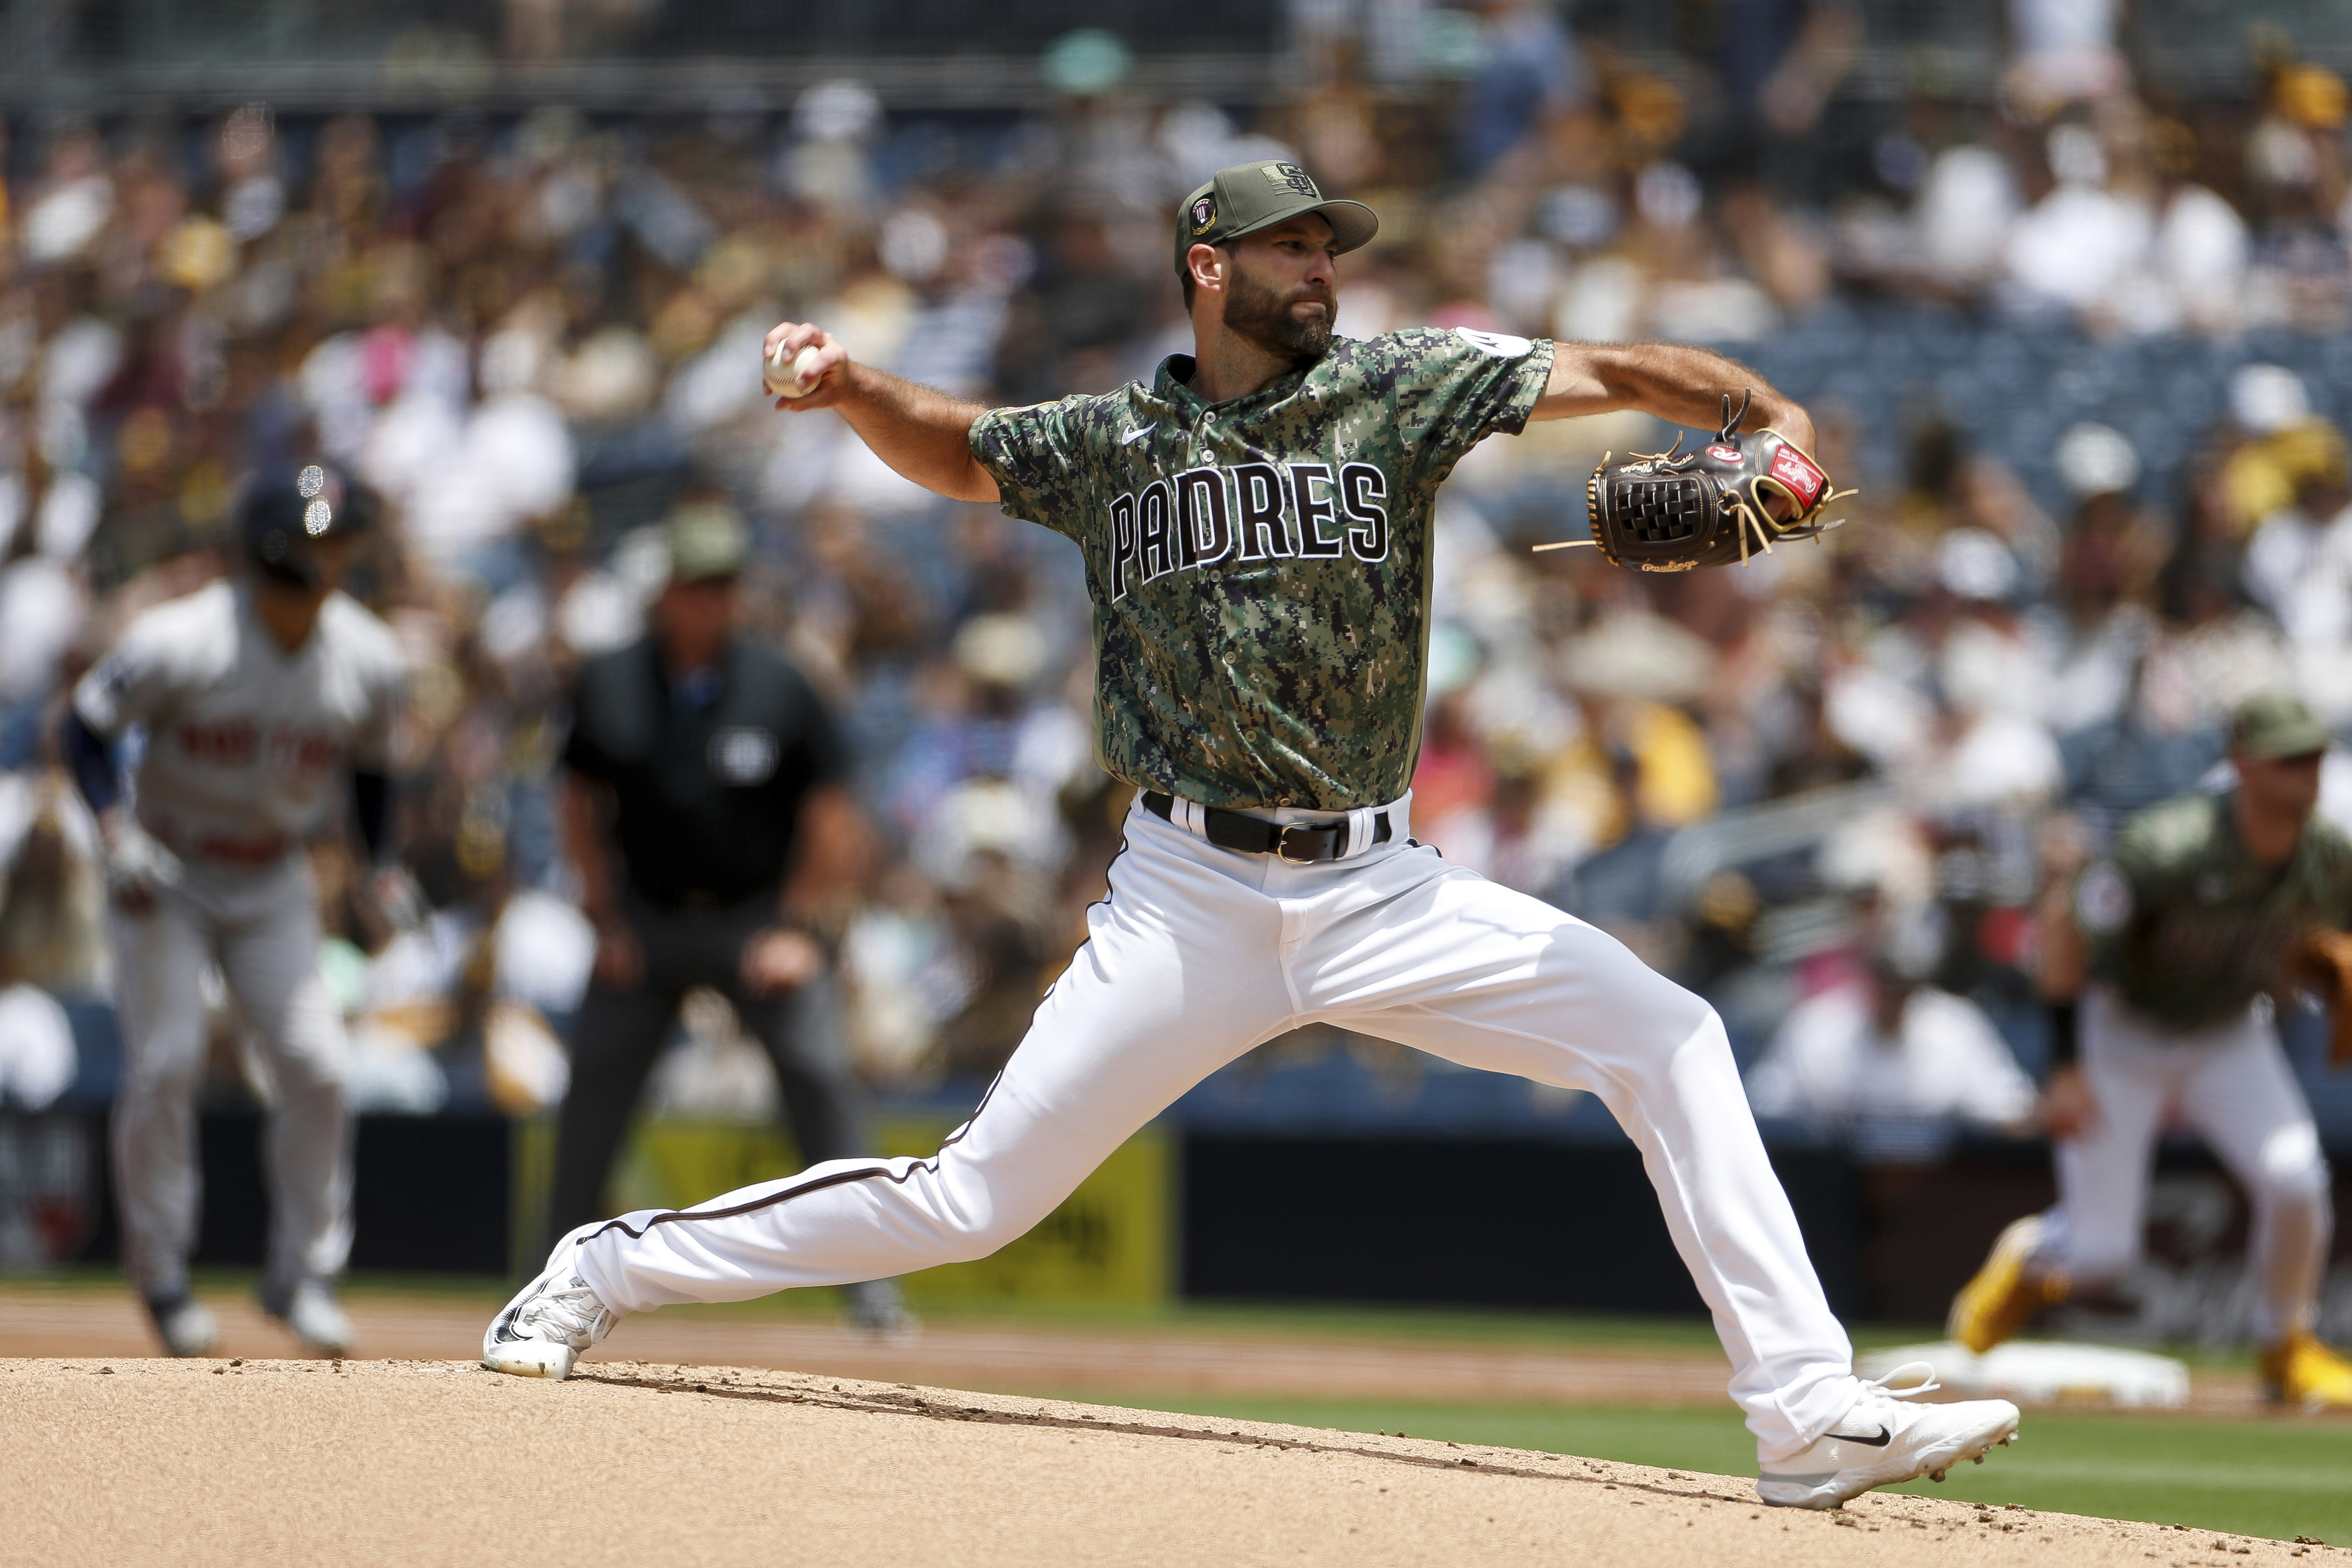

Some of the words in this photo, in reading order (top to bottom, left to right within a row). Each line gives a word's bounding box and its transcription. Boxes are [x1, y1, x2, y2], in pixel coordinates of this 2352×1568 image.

[1777, 461, 1816, 493] Rawlings
[1109, 462, 1388, 604] PADRES
[1641, 560, 1699, 572] Rawlings
